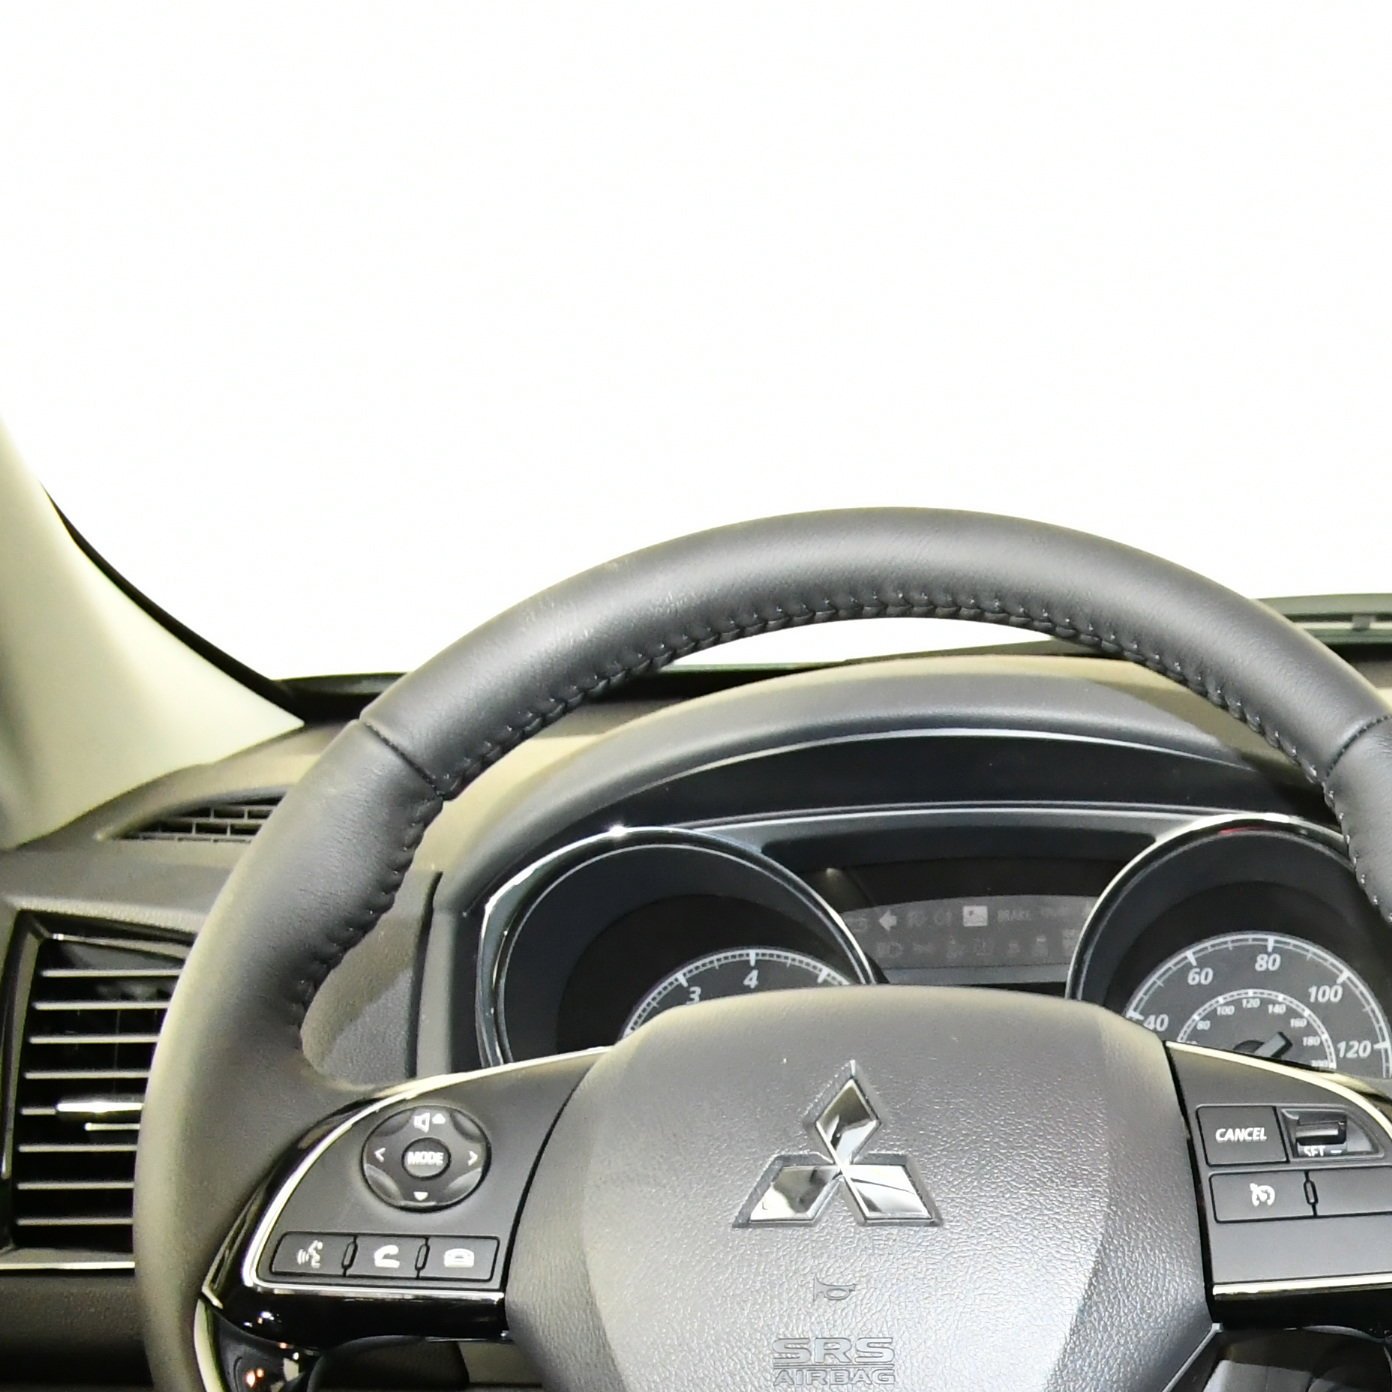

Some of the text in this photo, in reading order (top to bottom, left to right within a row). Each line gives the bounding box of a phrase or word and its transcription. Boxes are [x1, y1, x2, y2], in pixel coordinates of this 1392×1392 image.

[1255, 953, 1281, 971] 80
[743, 969, 758, 988] 4
[1187, 967, 1213, 985] 60
[1308, 985, 1343, 1003] 100
[1217, 1005, 1235, 1015] 100
[1242, 999, 1260, 1008] 120
[1268, 1004, 1286, 1015] 140
[1143, 1014, 1169, 1031] 40
[1336, 1040, 1371, 1058] 120
[1215, 1127, 1267, 1142] CANCEL
[407, 1151, 444, 1165] MODE
[772, 1337, 895, 1363] SRS
[773, 1368, 896, 1386] AIRBAG
